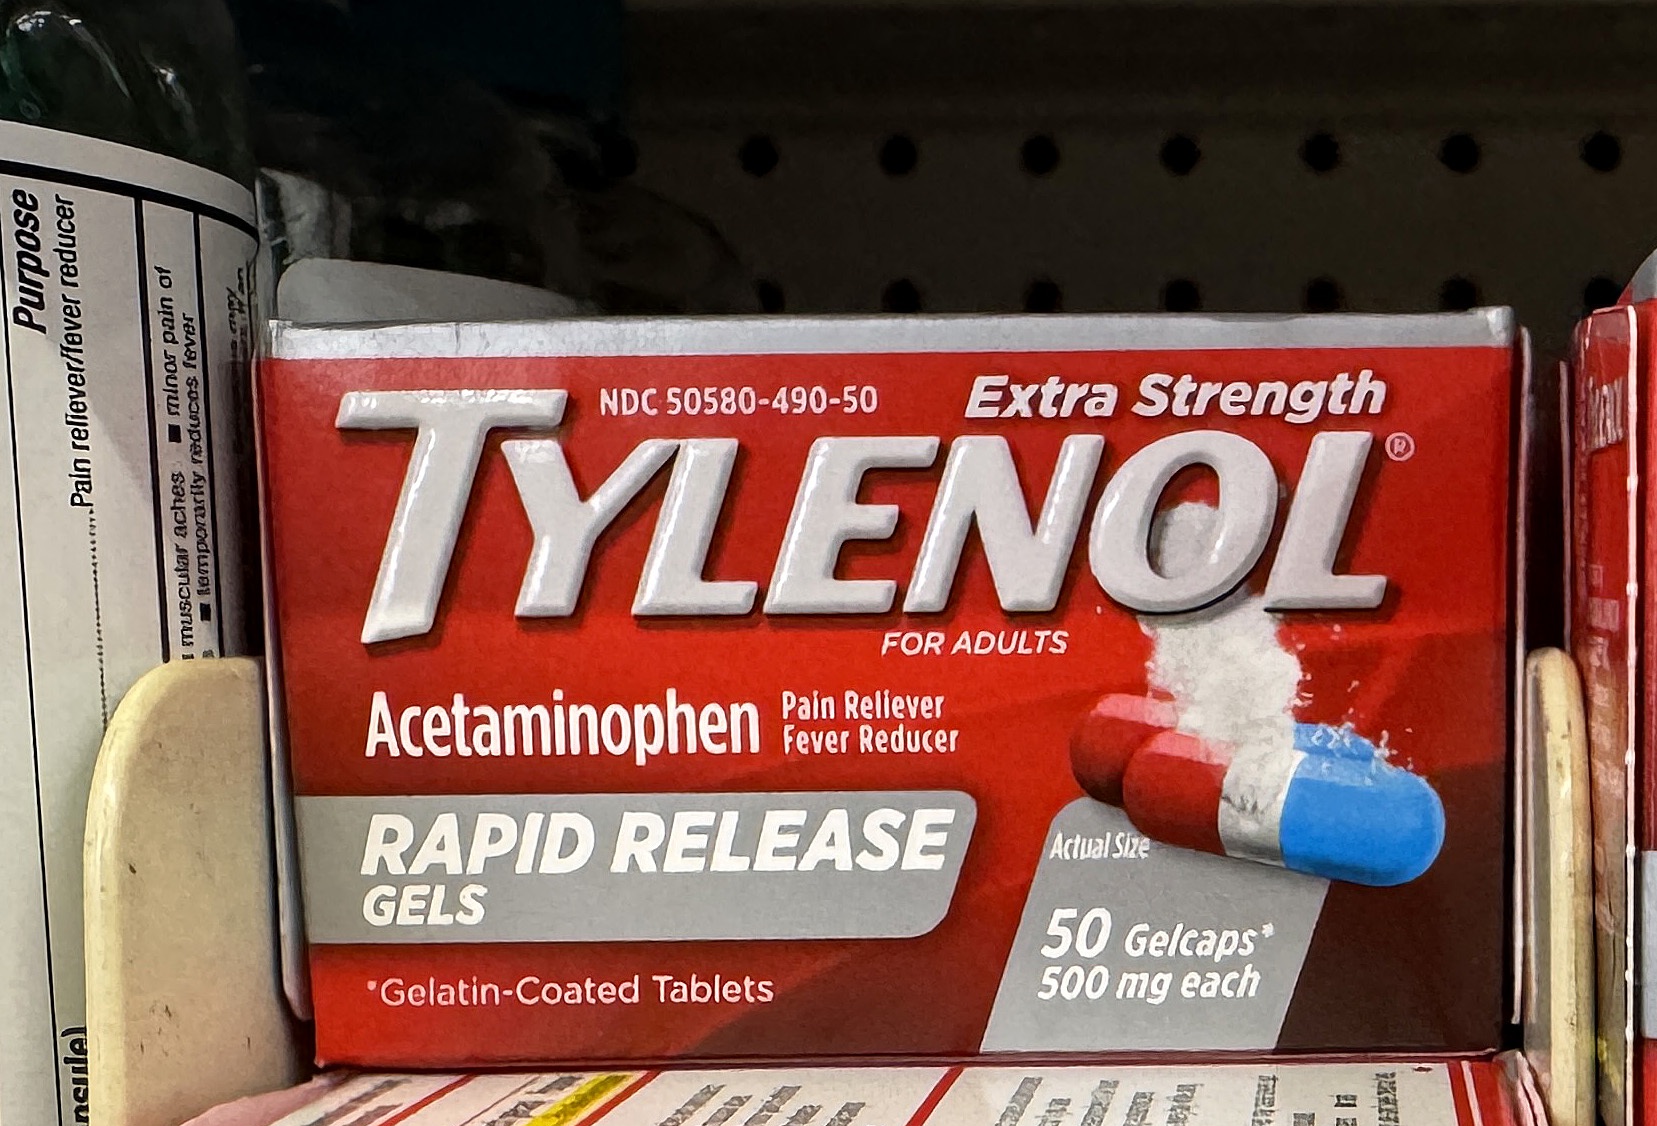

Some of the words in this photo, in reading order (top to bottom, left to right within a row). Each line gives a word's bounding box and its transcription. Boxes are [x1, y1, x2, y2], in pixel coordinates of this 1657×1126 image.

[12, 188, 50, 334] Purpose
[53, 193, 79, 288] reducer
[154, 265, 174, 289] of
[158, 296, 180, 345] pain
[182, 312, 197, 369] fever
[59, 294, 91, 451] reliever/fever
[163, 350, 181, 416] minor
[964, 374, 1118, 418] Extra
[1132, 369, 1387, 423] Strength
[600, 387, 657, 417] NDC
[666, 385, 878, 415] 50580-490-50
[68, 459, 94, 507] Pain
[170, 471, 189, 538] aches
[174, 545, 195, 647] muscular
[881, 631, 947, 657] FOR
[952, 630, 1069, 656] ADULTS
[365, 688, 760, 765] Acetaminophen
[781, 691, 835, 721] Pain
[845, 689, 945, 721] Reliever
[783, 724, 848, 755] Fever
[859, 723, 959, 755] Reducer
[361, 812, 596, 876] RAPID
[610, 808, 956, 874] RELEASE
[1050, 831, 1109, 861] Actual
[1112, 831, 1150, 861] Size
[361, 884, 488, 926] GELS
[1040, 907, 1112, 960] 50
[652, 972, 774, 1005] Tablets
[1037, 965, 1108, 1001] 500
[1116, 969, 1172, 1005] mg
[1180, 963, 1261, 999] each
